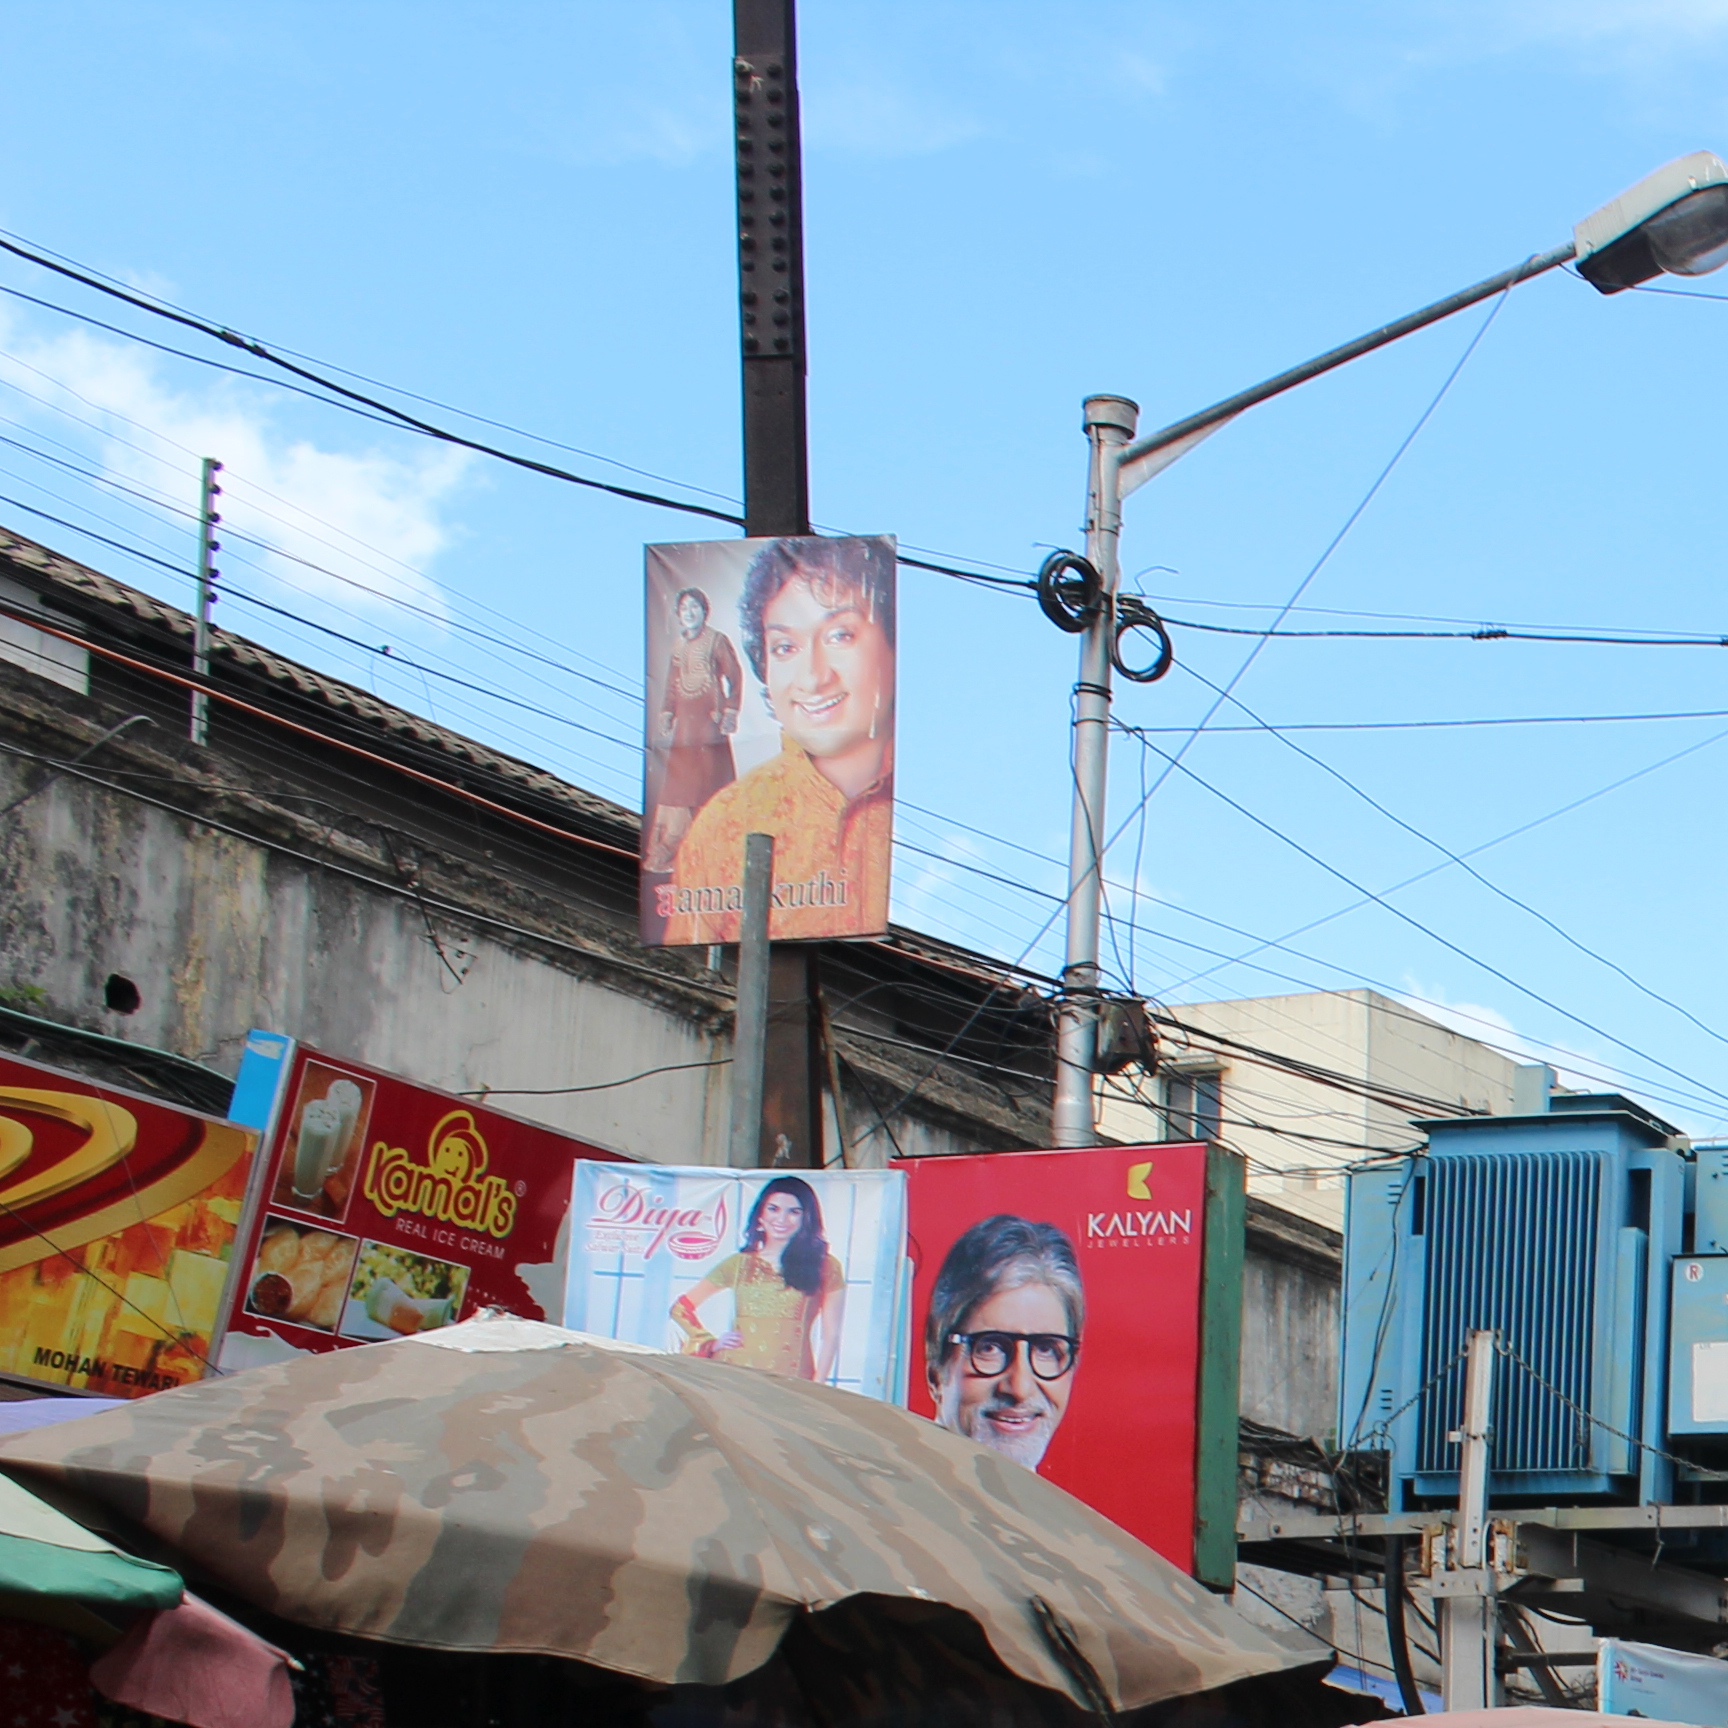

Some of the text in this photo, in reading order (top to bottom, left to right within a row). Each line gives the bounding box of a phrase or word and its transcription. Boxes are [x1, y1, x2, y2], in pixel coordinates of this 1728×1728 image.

[363, 1141, 517, 1238] Kamal's
[591, 1184, 702, 1259] Diya
[1088, 1209, 1192, 1238] KALYAN
[396, 1217, 505, 1260] REAL ICE CREAM
[1087, 1237, 1191, 1248] JEWELLERS
[1688, 1265, 1698, 1281] R
[33, 1347, 107, 1378] MOHAN
